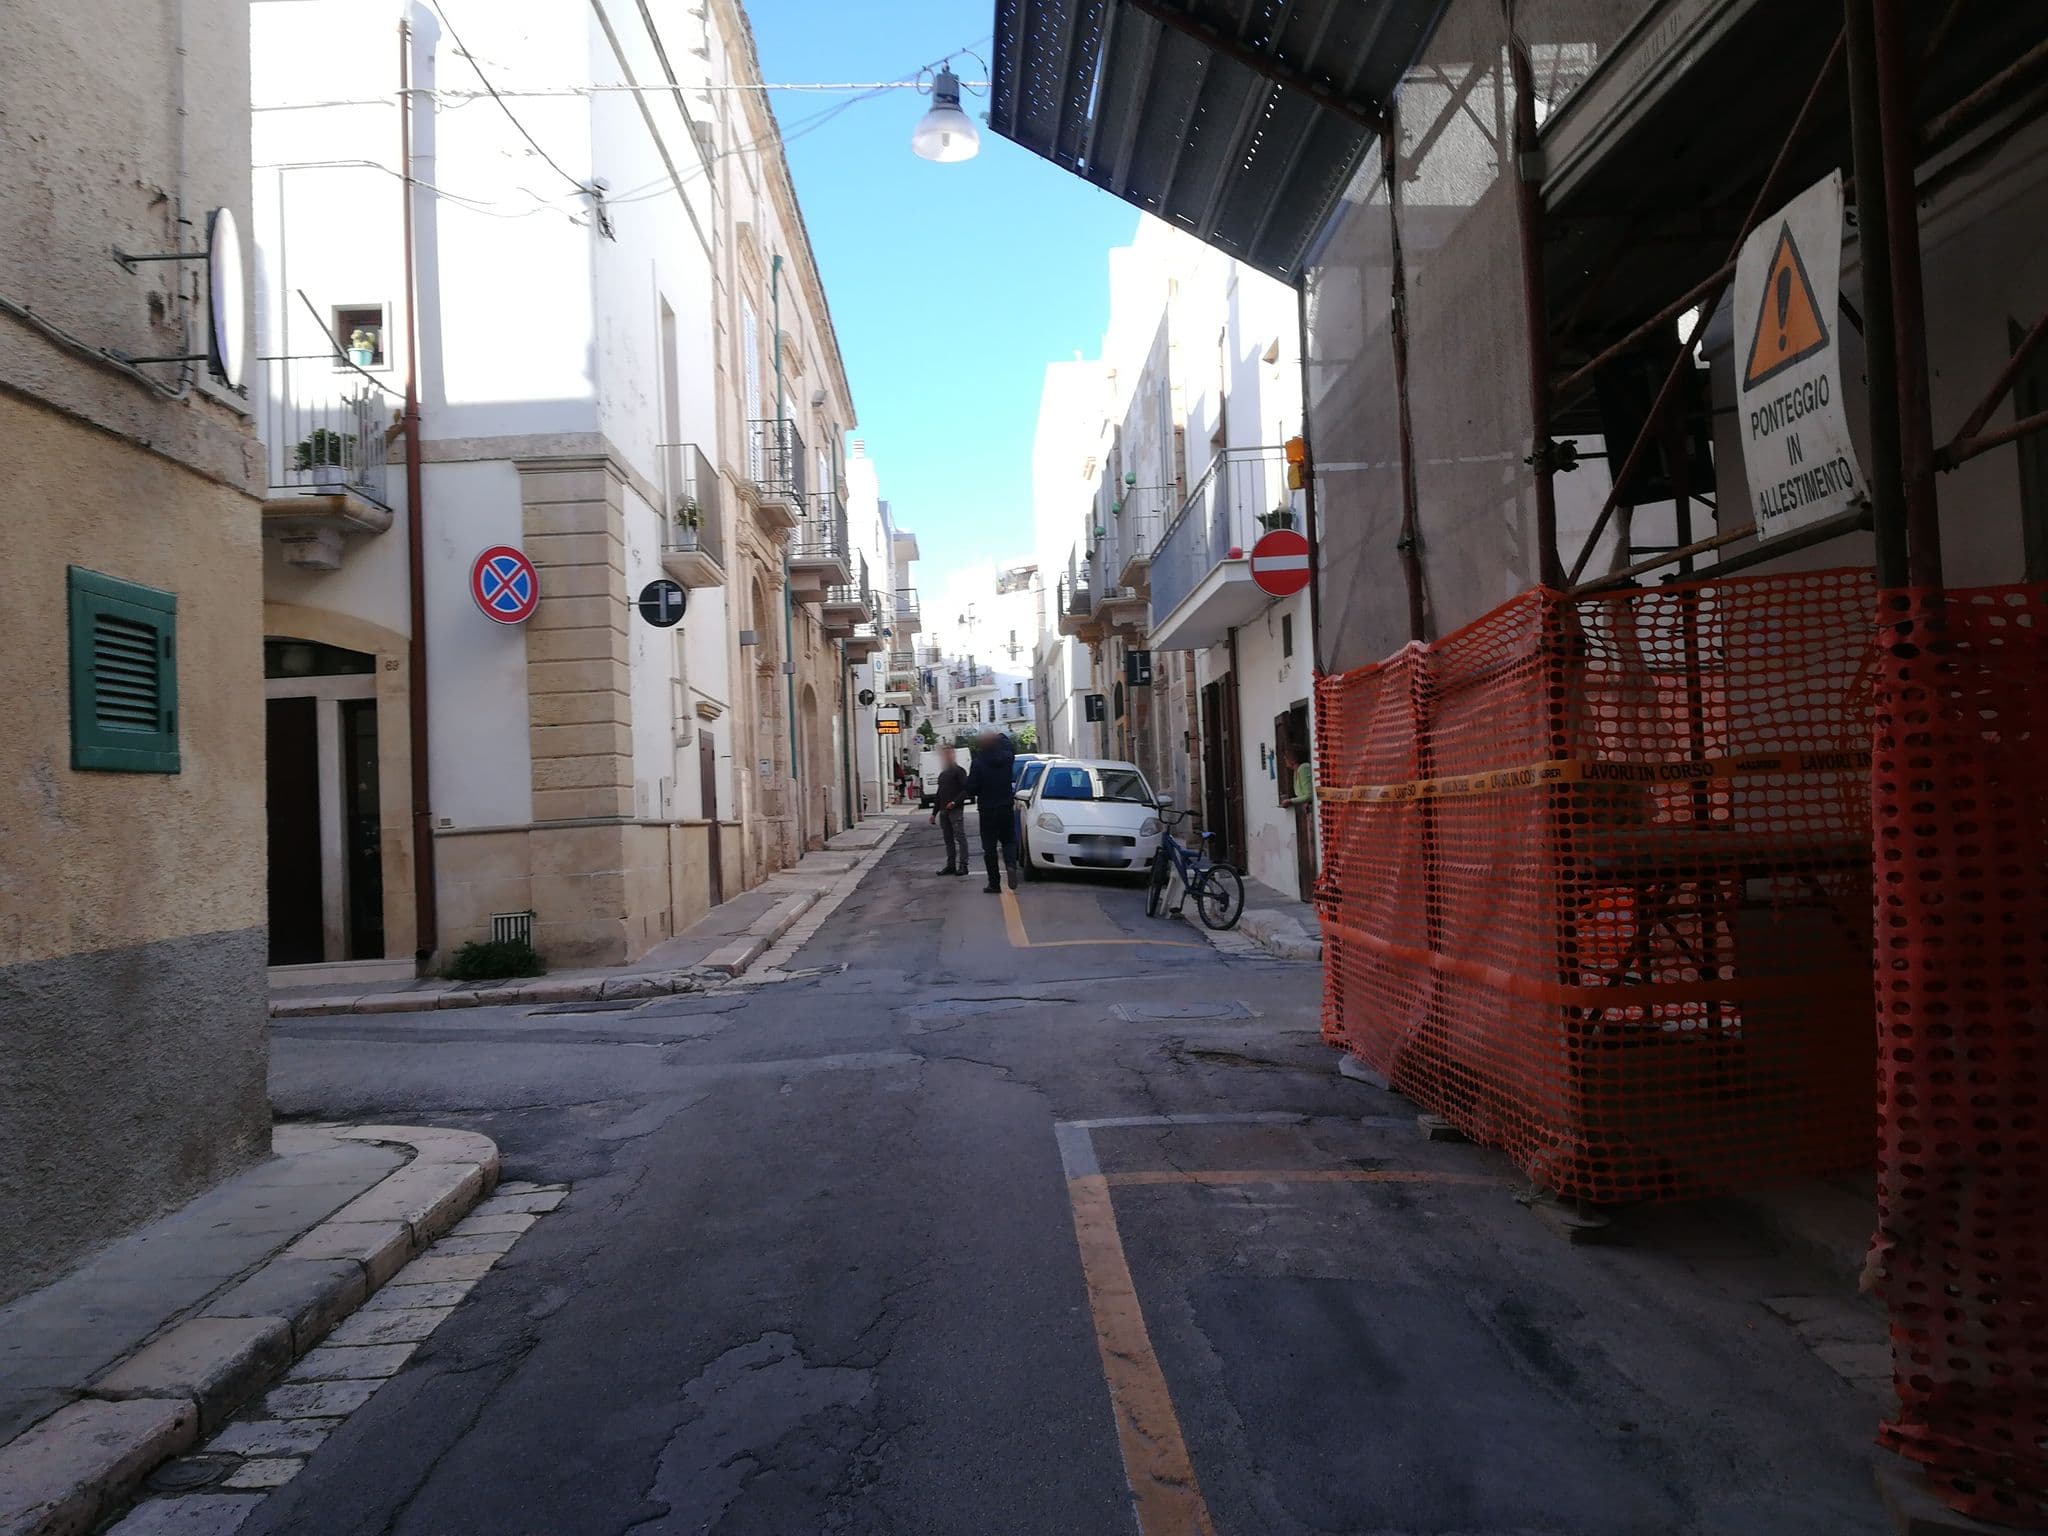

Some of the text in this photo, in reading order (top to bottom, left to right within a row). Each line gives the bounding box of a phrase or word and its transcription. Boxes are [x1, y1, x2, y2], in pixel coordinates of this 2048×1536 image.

[1751, 374, 1829, 440] PONTEGGIO
[1787, 433, 1803, 466] IN
[1760, 456, 1854, 520] ALLESTIMENTO
[1582, 764, 1633, 780] LAVORI
[1640, 765, 1656, 781] IN
[1660, 762, 1714, 780] CORSO
